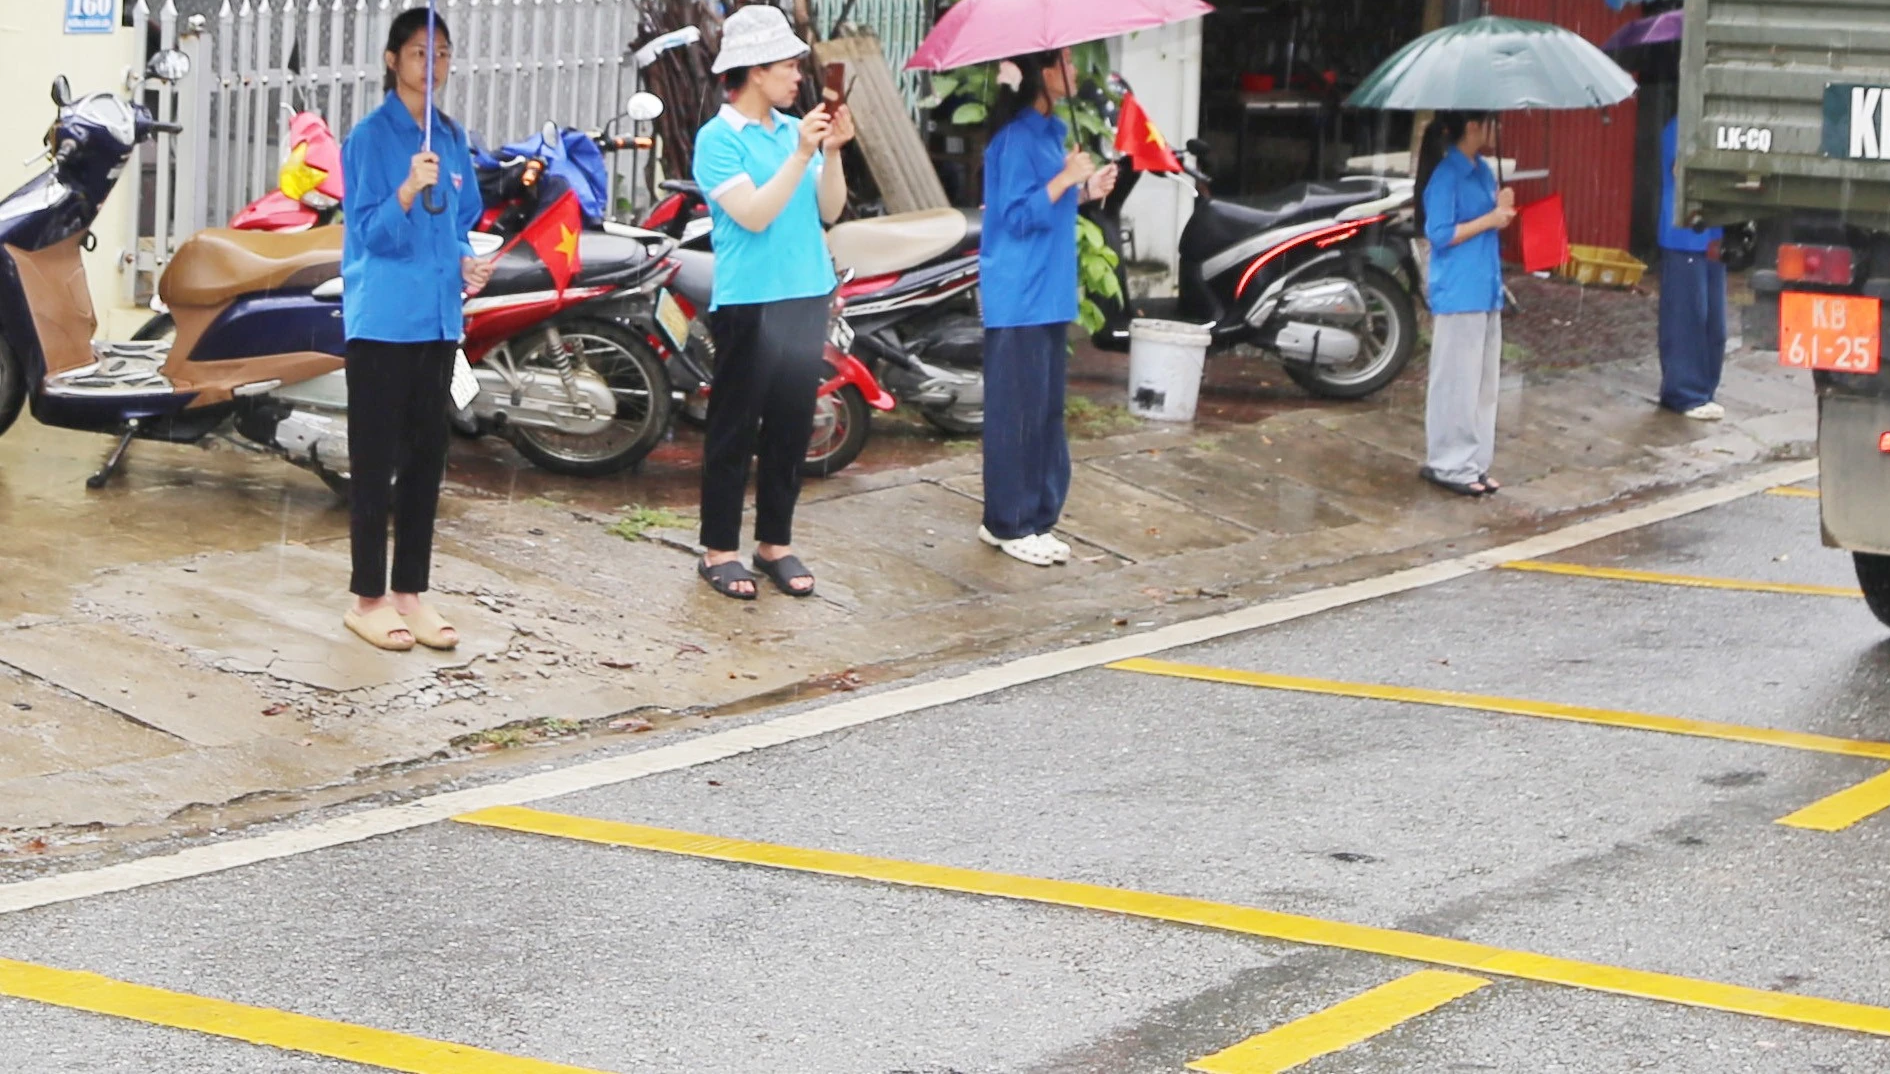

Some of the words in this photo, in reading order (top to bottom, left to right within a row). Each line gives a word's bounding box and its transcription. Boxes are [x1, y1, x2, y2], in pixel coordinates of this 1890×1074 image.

[1716, 126, 1772, 153] LK-CQ
[1812, 298, 1847, 331] KB
[1788, 333, 1870, 369] 61-25
